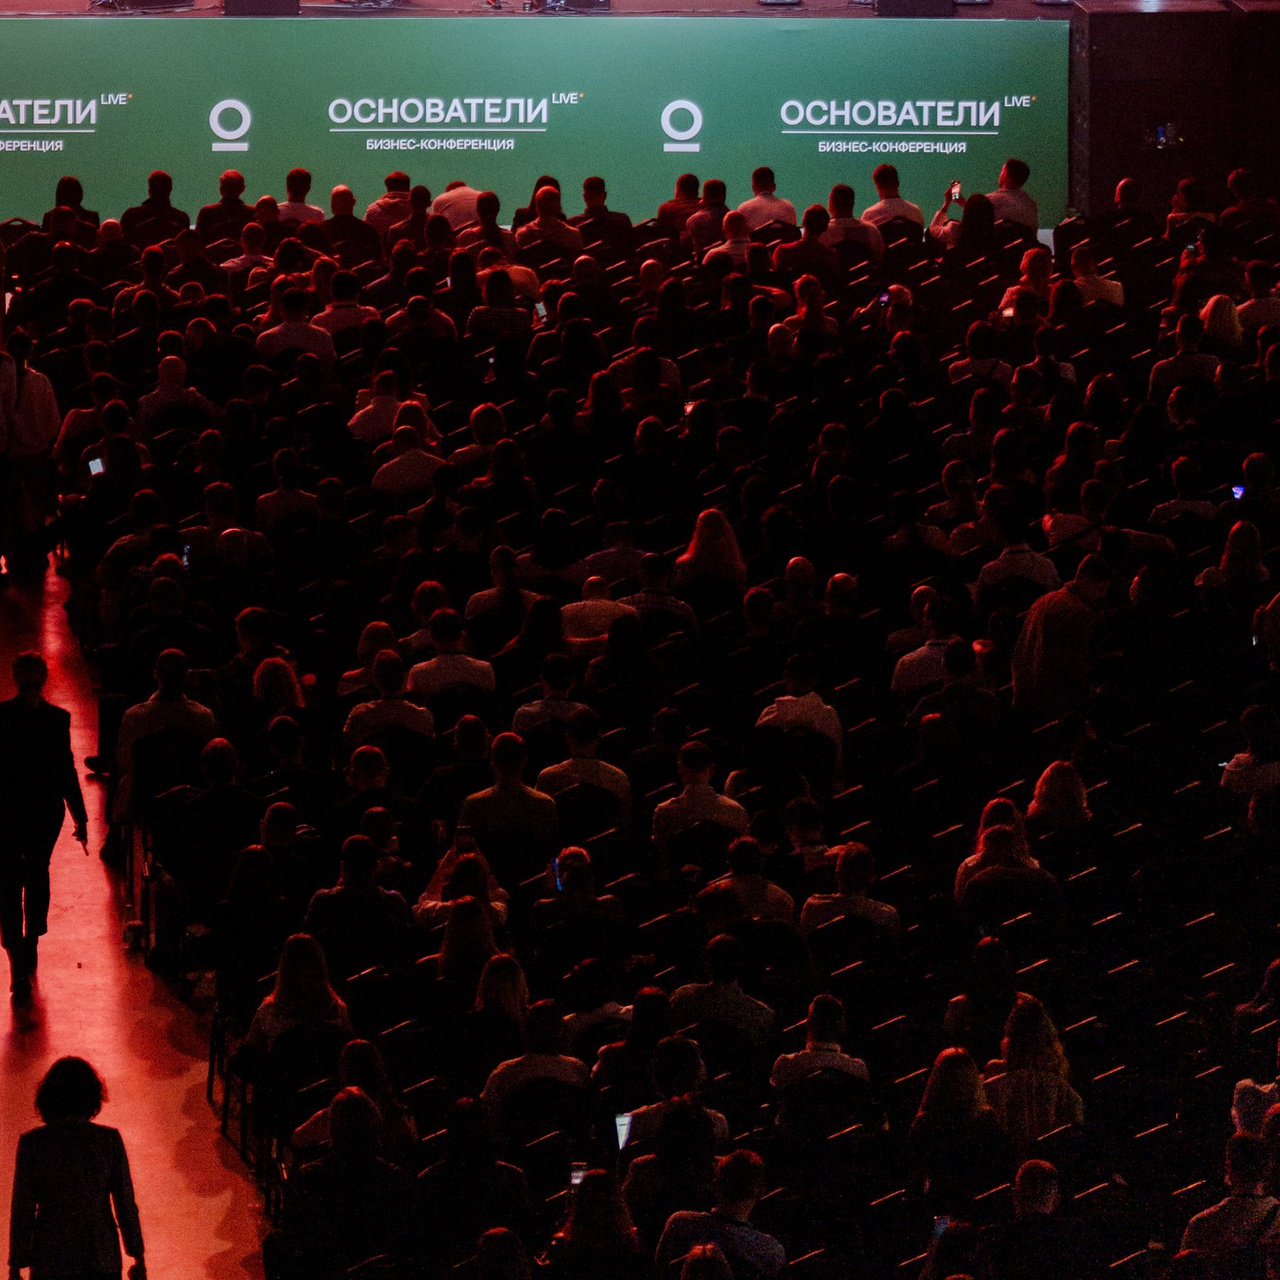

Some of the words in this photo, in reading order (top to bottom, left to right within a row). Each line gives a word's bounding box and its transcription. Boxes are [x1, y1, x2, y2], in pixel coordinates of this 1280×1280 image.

[328, 97, 548, 125] ОСНОВАТЕЛИ
[780, 99, 1000, 128] ОСНОВАТЕЛИ
[366, 138, 515, 152] БИЗНЕС-КОНФЕРЕНЦИЯ
[818, 141, 966, 155] БИЗНЕС-КОНФЕРЕНЦИЯ
